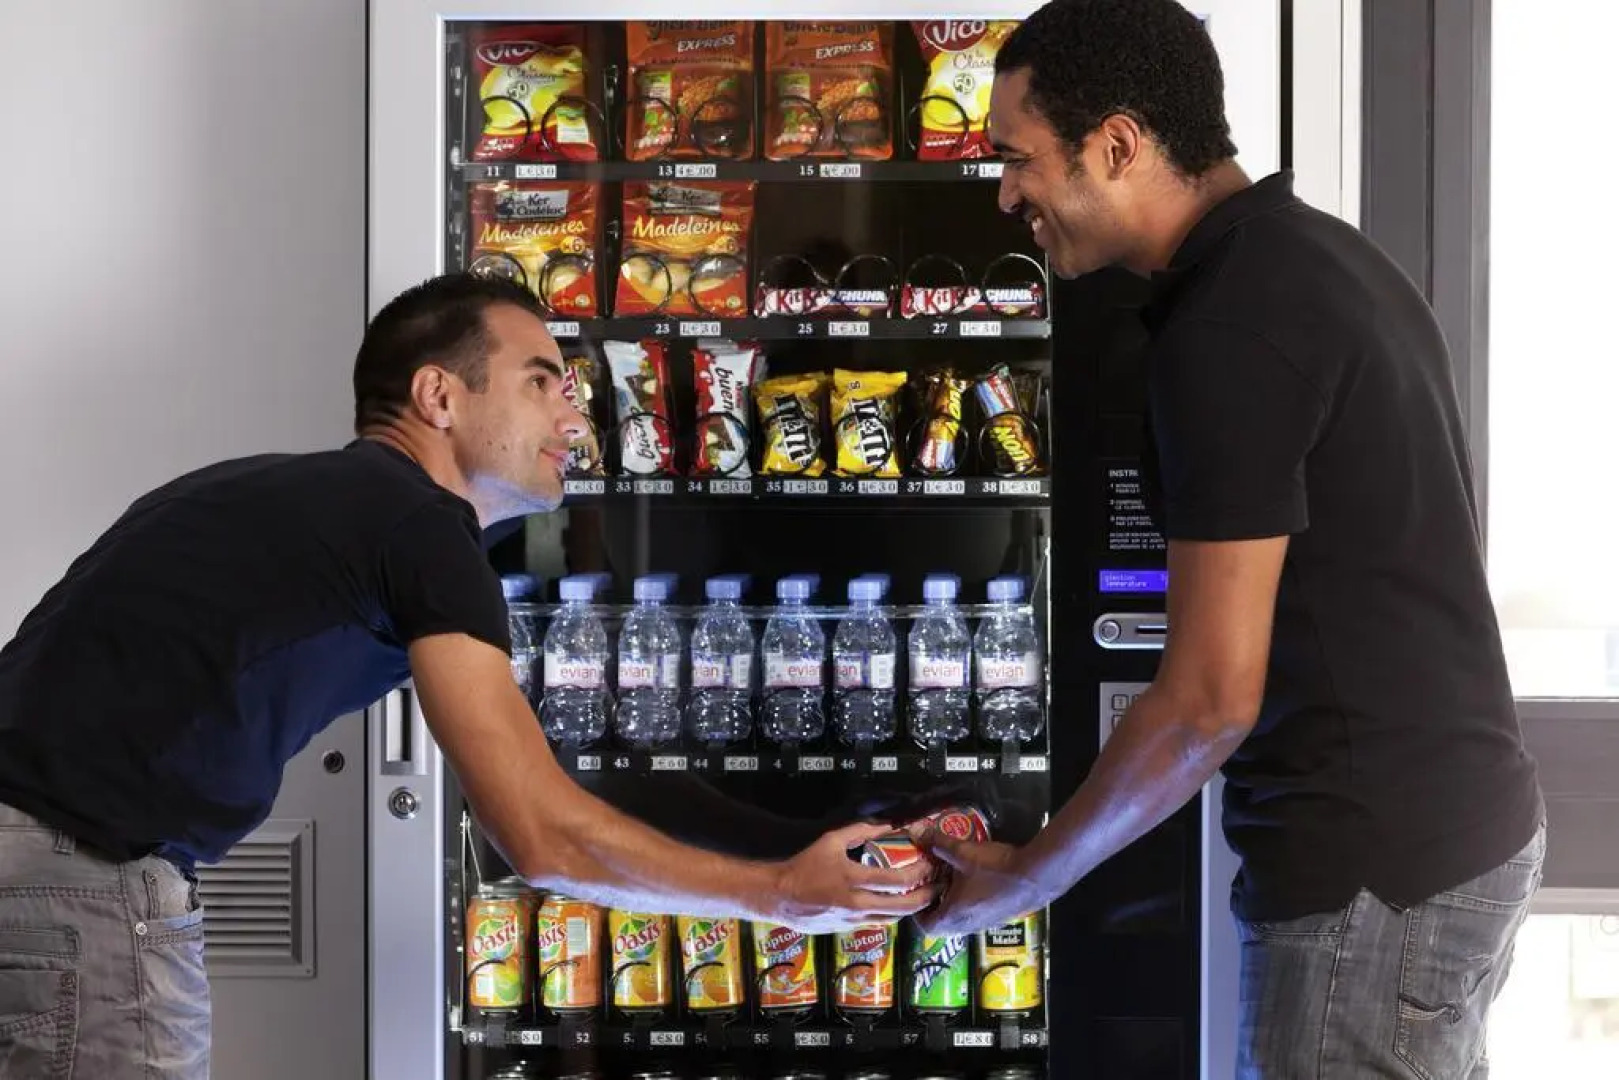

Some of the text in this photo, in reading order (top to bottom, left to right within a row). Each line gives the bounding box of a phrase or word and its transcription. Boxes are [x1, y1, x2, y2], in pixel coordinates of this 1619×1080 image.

[933, 20, 986, 44] Vico
[678, 35, 735, 52] EXPRESS
[487, 166, 499, 176] 11
[658, 166, 672, 176] 13
[800, 166, 814, 176] 15
[962, 164, 978, 176] 17
[632, 213, 742, 239] Madeleines
[480, 219, 587, 244] Madeleines
[985, 290, 1034, 302] CHUNK
[656, 324, 670, 334] 23
[798, 324, 812, 334] 25
[932, 323, 948, 334] 27
[714, 367, 734, 411] buen
[616, 482, 631, 492] 33
[688, 481, 702, 492] 34
[766, 482, 781, 493] 35
[839, 482, 854, 492] 36
[907, 482, 922, 493] 37
[982, 482, 997, 492] 38
[560, 665, 597, 678] evian
[922, 664, 960, 678] evian
[986, 664, 1024, 678] evian
[582, 758, 598, 768] 60
[614, 758, 630, 768] 43
[694, 758, 756, 768] 44 €60
[773, 758, 832, 768] 4 €60
[841, 758, 856, 769] 46
[981, 758, 996, 769] 48
[614, 918, 660, 954] Oasis
[468, 1032, 483, 1042] 51
[576, 1033, 590, 1043] 52
[623, 1032, 634, 1043] 5
[754, 1034, 769, 1044] 55
[846, 1034, 854, 1044] 5
[904, 1034, 919, 1044] 57
[1022, 1034, 1038, 1044] 58
